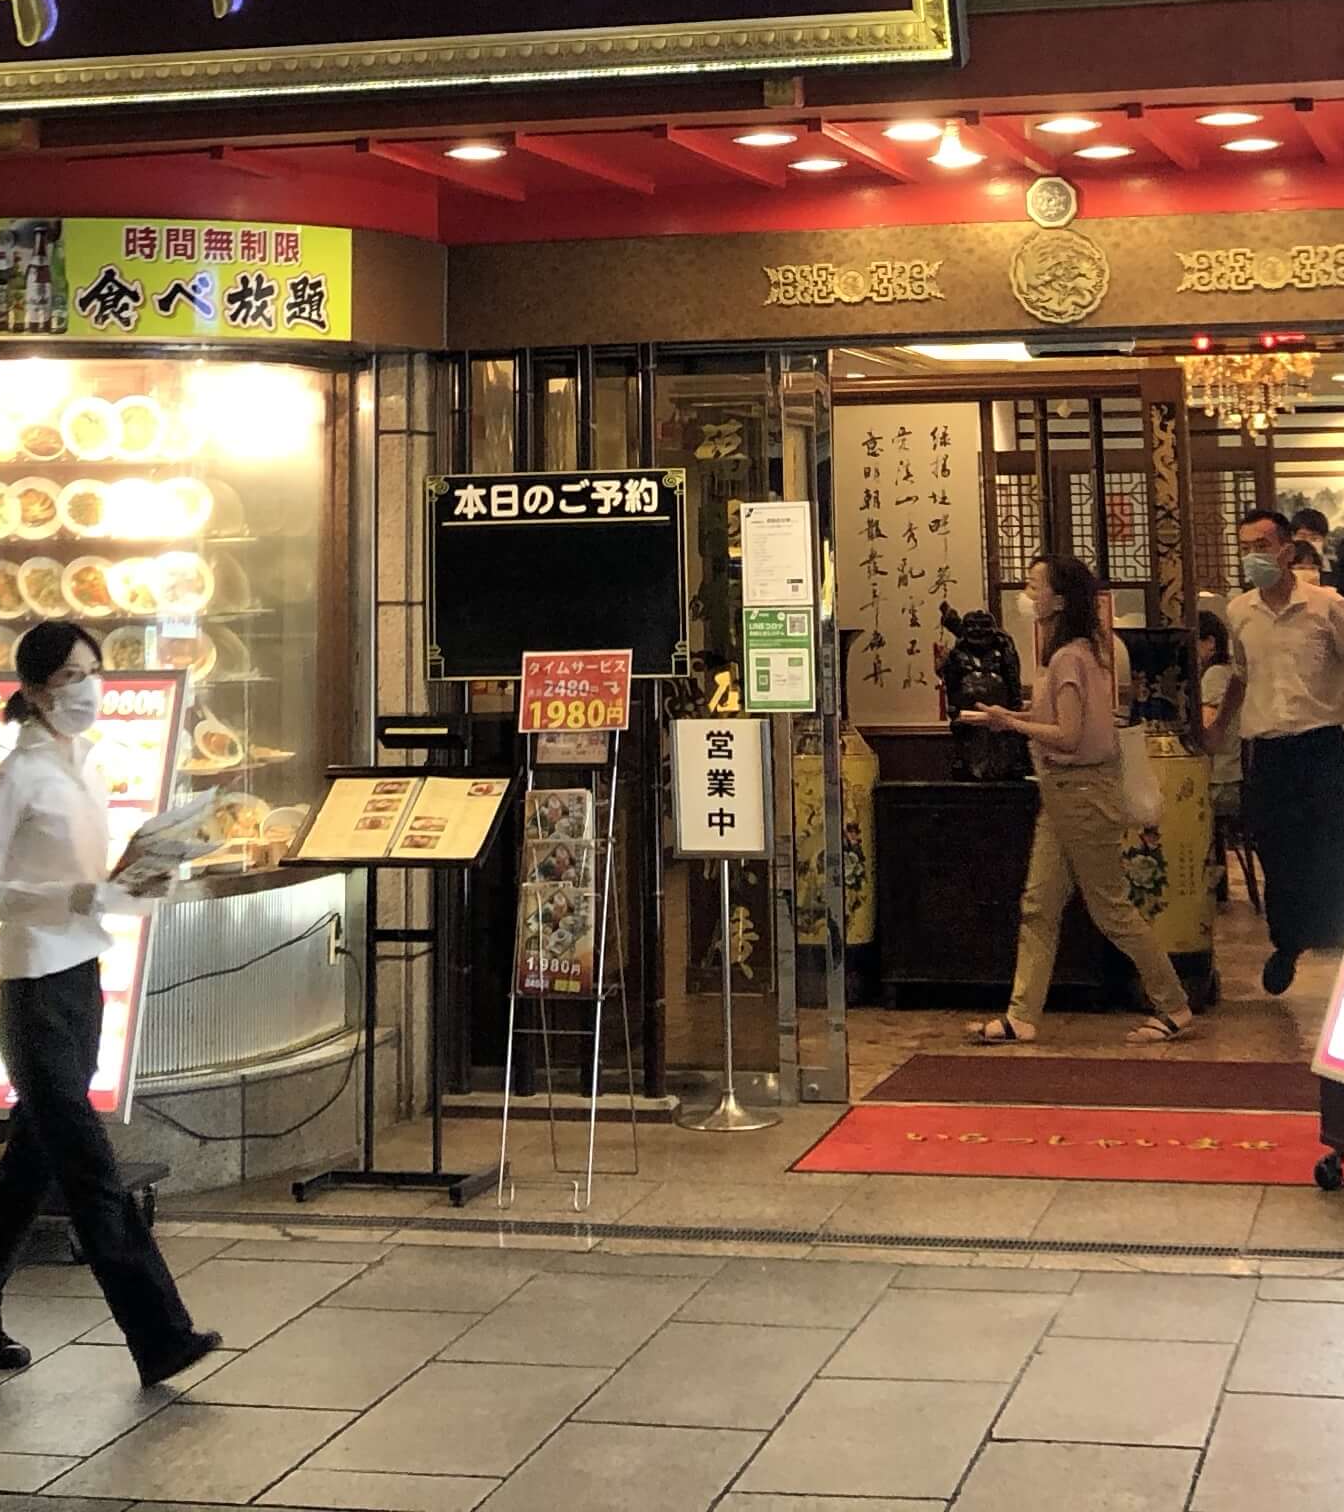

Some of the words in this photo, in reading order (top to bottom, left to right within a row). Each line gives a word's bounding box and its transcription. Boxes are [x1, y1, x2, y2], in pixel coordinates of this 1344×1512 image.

[123, 225, 302, 264] 時間無制限
[78, 268, 329, 333] 食べ放題
[453, 478, 658, 519] 本日のご予約
[528, 659, 626, 676] タイムサービス
[706, 730, 735, 837] 営業中
